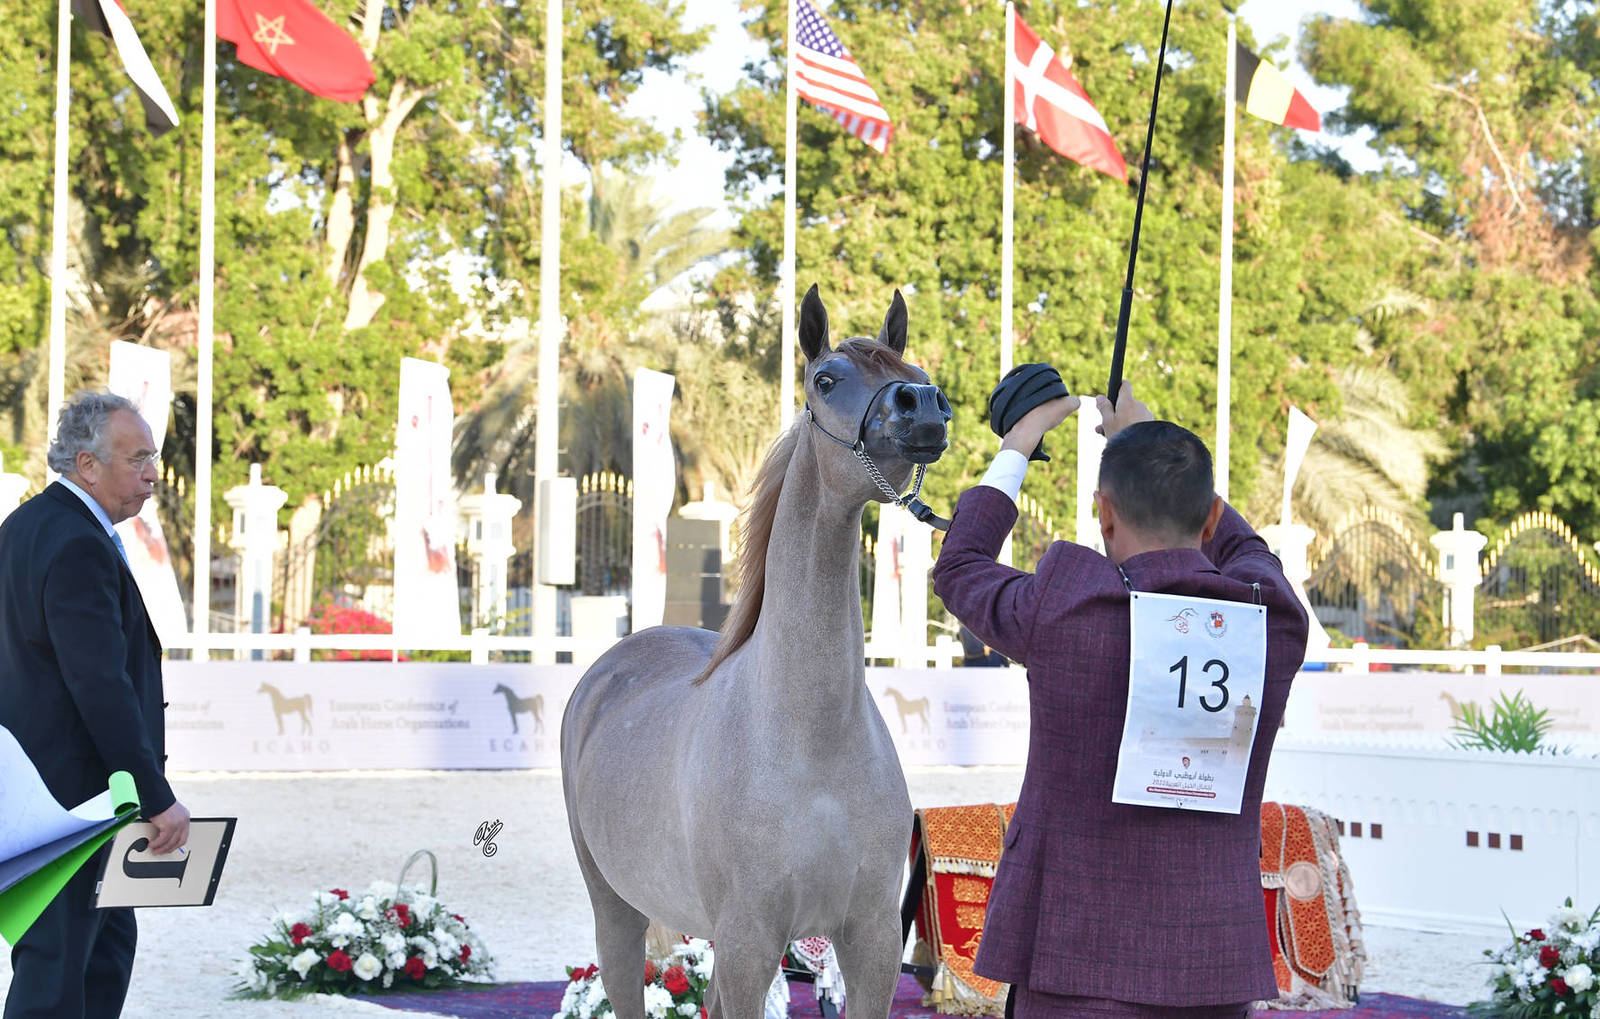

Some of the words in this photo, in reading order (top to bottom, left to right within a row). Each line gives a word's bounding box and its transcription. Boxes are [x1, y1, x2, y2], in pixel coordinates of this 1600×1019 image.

[1169, 655, 1230, 713] 13
[329, 700, 382, 715] European
[384, 698, 446, 712] Conference
[448, 699, 460, 716] of
[332, 716, 358, 729] Arab
[360, 716, 394, 729] Horse
[252, 740, 330, 754] ECAHO
